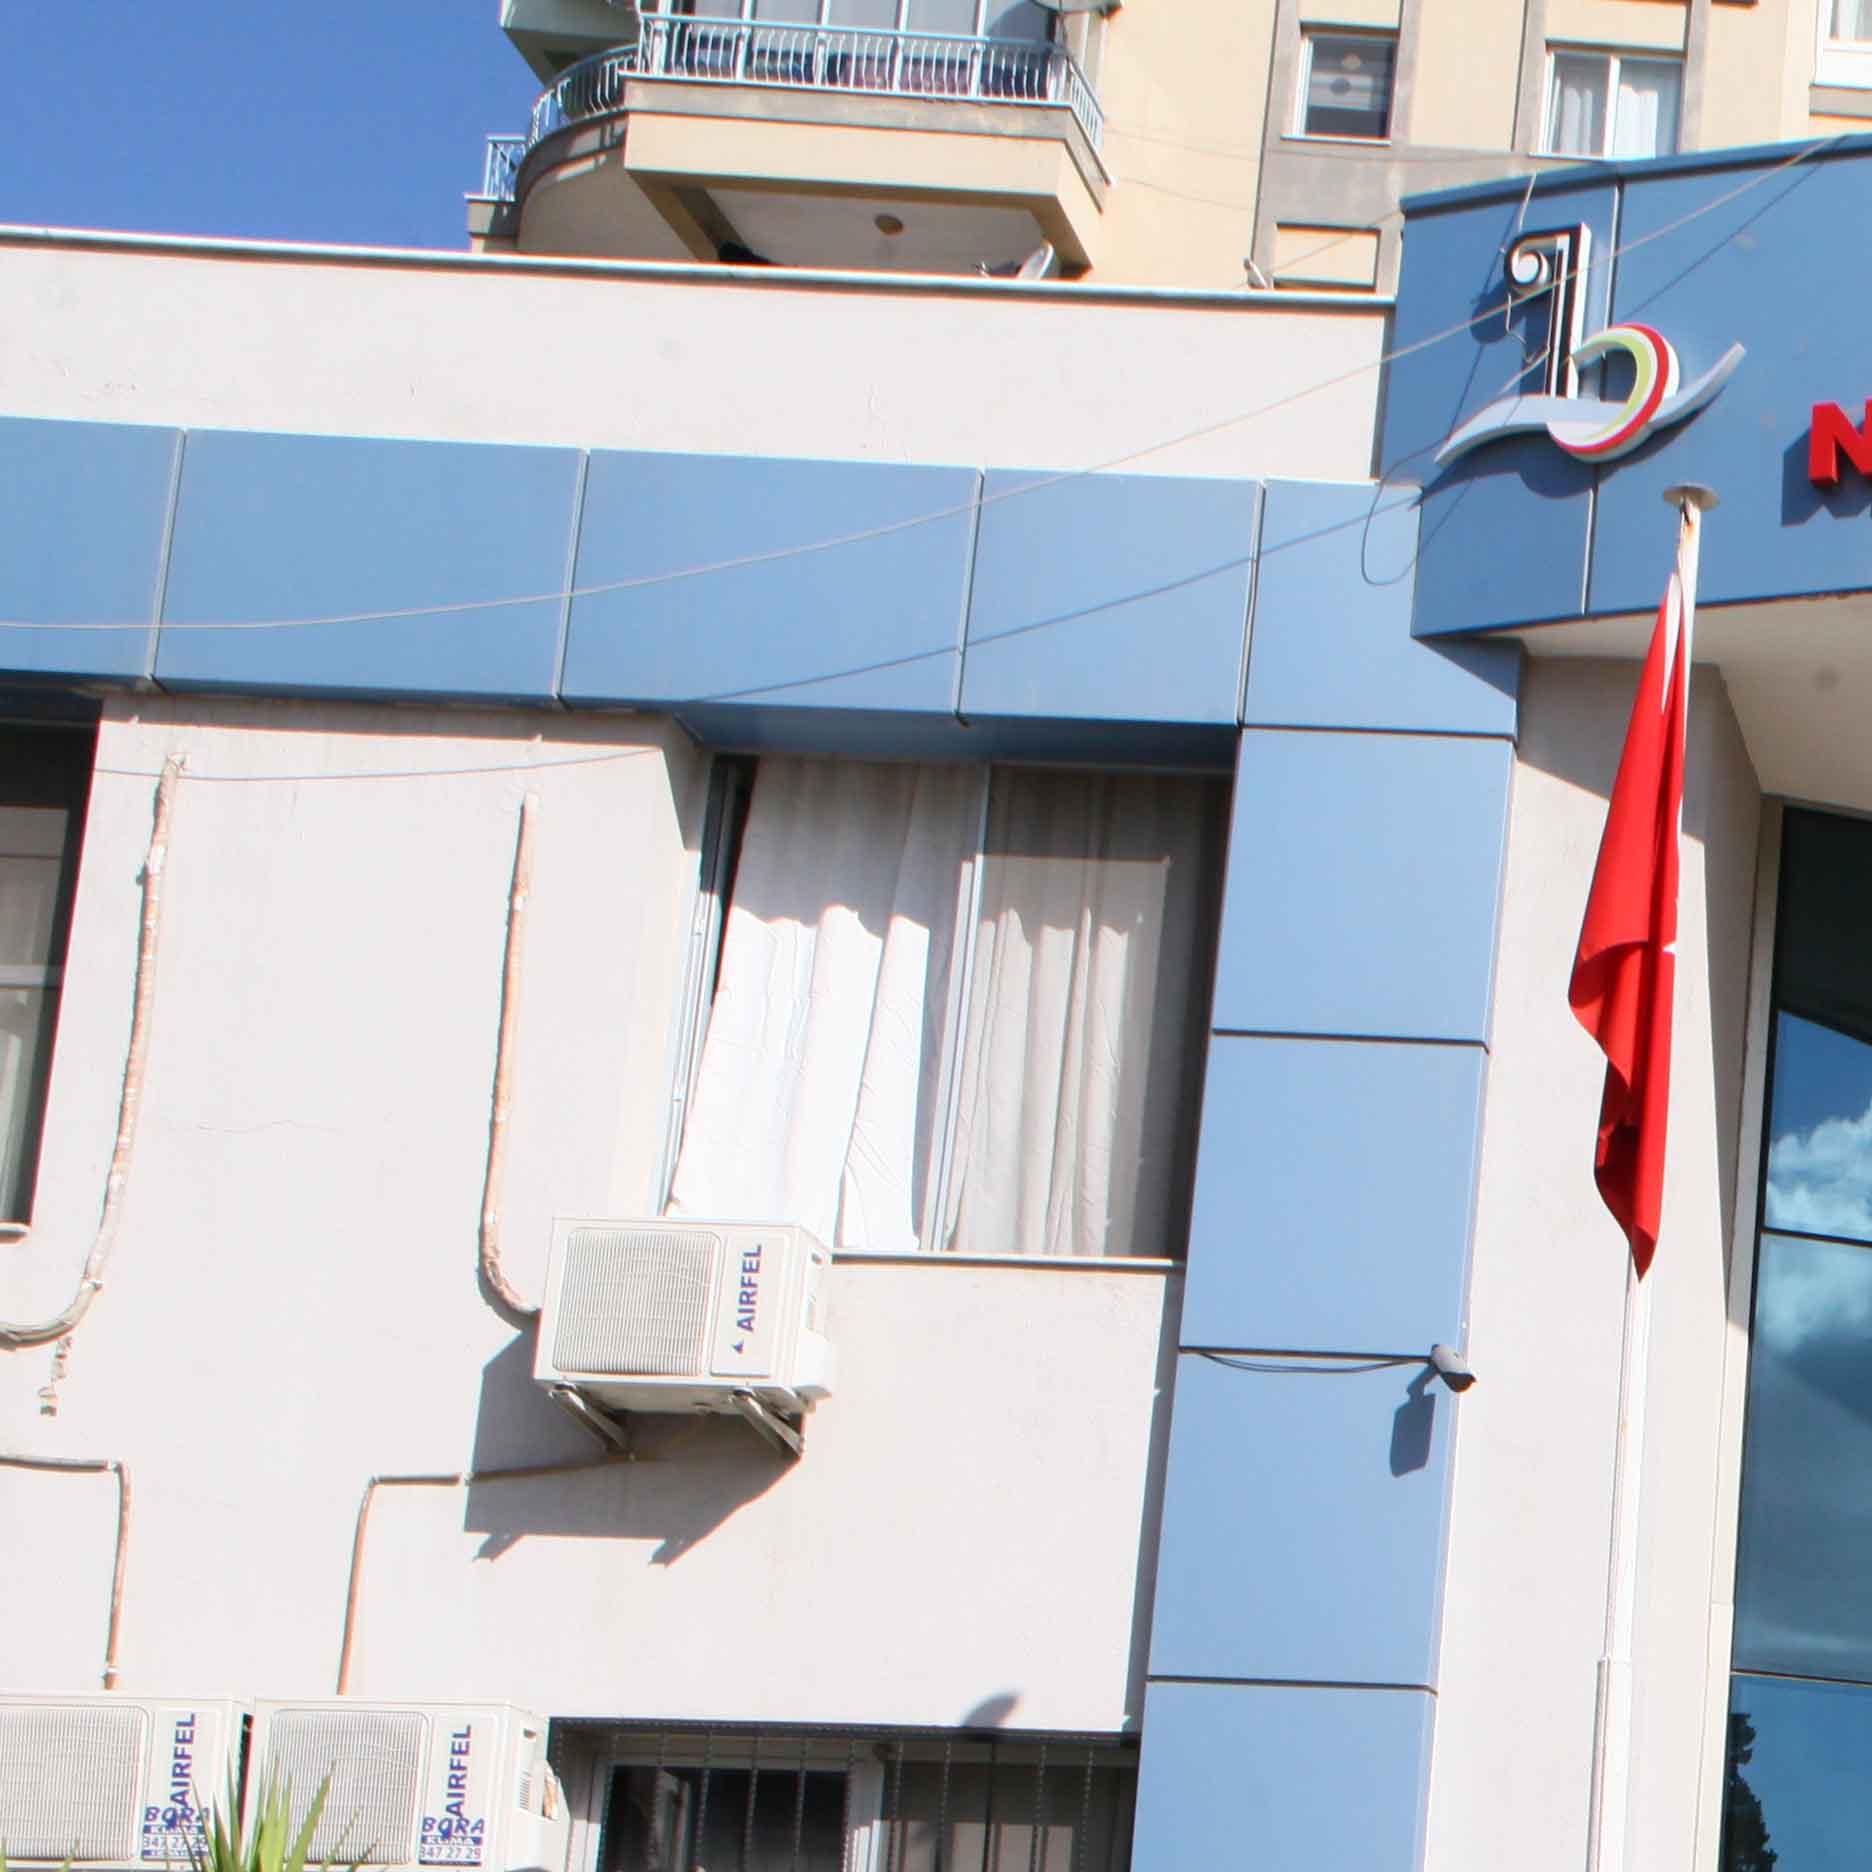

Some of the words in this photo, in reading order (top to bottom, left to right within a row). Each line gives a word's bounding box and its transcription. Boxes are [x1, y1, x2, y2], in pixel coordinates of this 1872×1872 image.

[736, 1243, 761, 1333] AIRFEL
[169, 1713, 196, 1809] AIRFEL
[445, 1724, 472, 1818] AIRFEL
[420, 1846, 442, 1858] 347
[446, 1847, 463, 1859] 27
[421, 1817, 486, 1837] BORA
